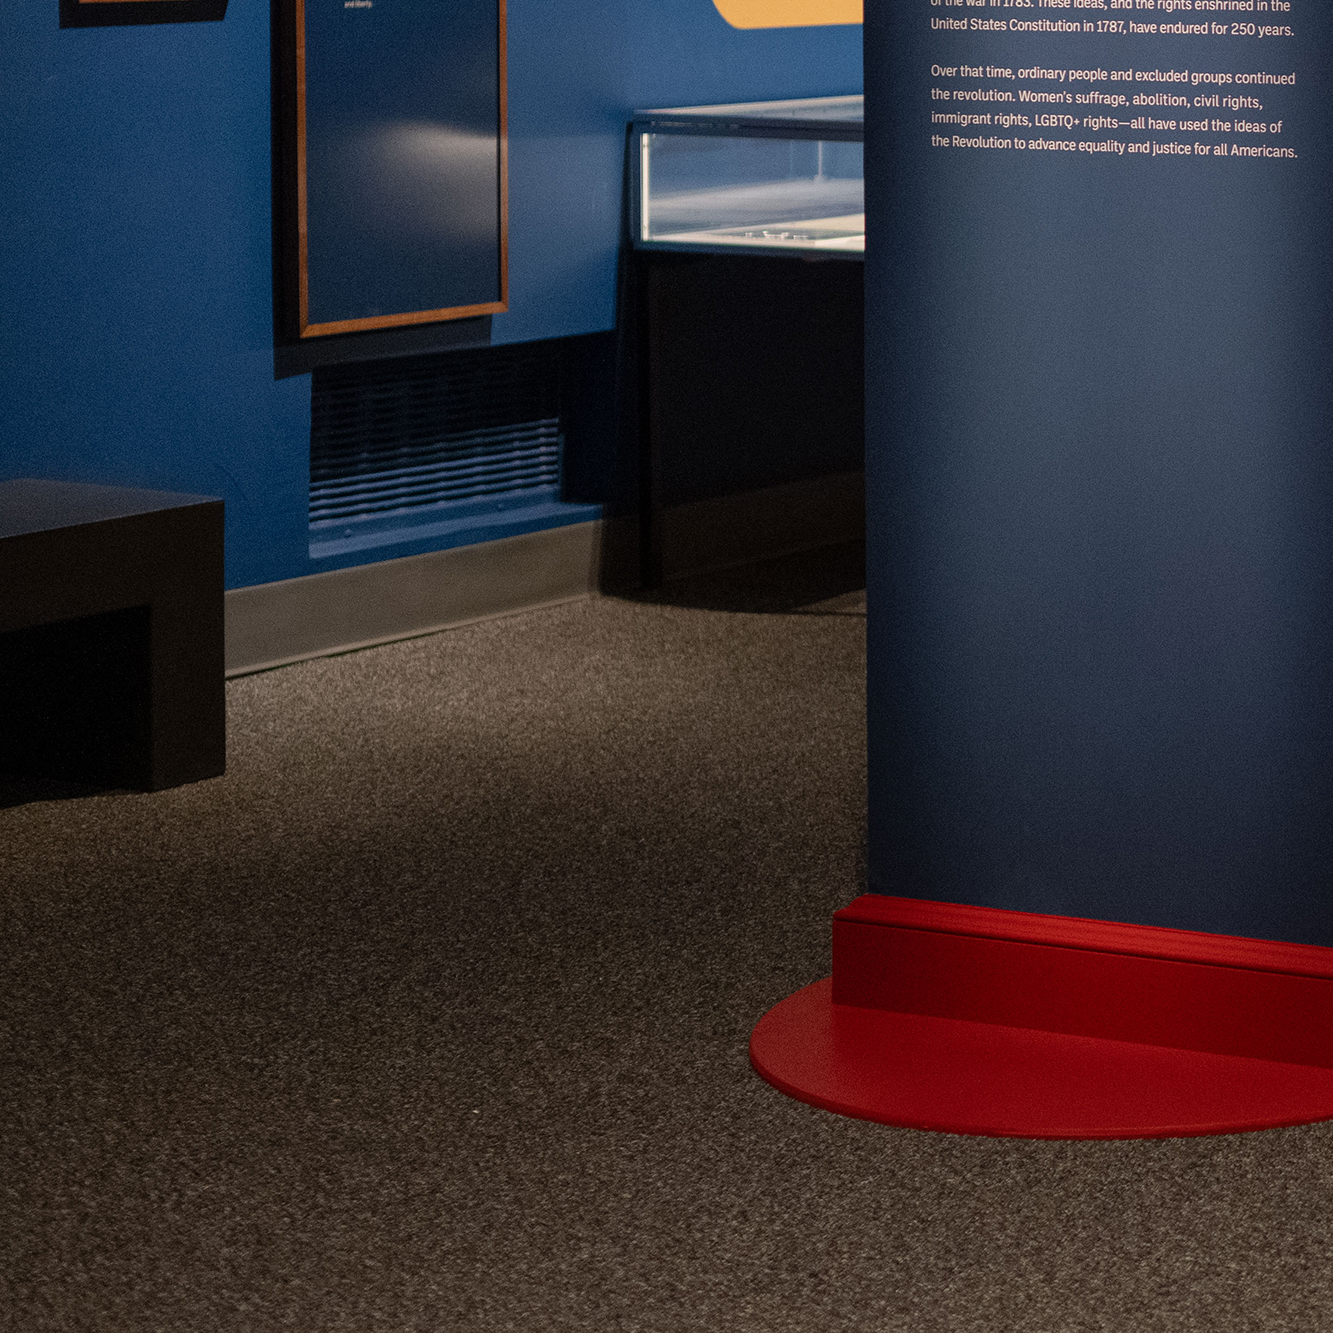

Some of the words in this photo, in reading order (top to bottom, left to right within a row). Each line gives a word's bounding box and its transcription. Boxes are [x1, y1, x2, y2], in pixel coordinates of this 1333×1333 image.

[930, 17, 967, 30] United
[969, 17, 1007, 31] States
[1009, 18, 1080, 33] Constitution
[1083, 19, 1094, 33] in
[1096, 20, 1126, 35] 1787,
[1129, 20, 1157, 34] have
[1159, 21, 1208, 35] endured
[1210, 21, 1228, 35] for
[1230, 22, 1255, 36] 250
[1257, 25, 1294, 39] years.
[930, 64, 957, 77] Over
[959, 64, 983, 78] that
[985, 65, 1015, 81] time,
[1017, 66, 1066, 83] ordinary
[1068, 67, 1107, 83] people
[1110, 68, 1132, 82] and
[1134, 68, 1188, 83] excluded
[1190, 72, 1232, 86] groups
[1234, 71, 1295, 85] continued
